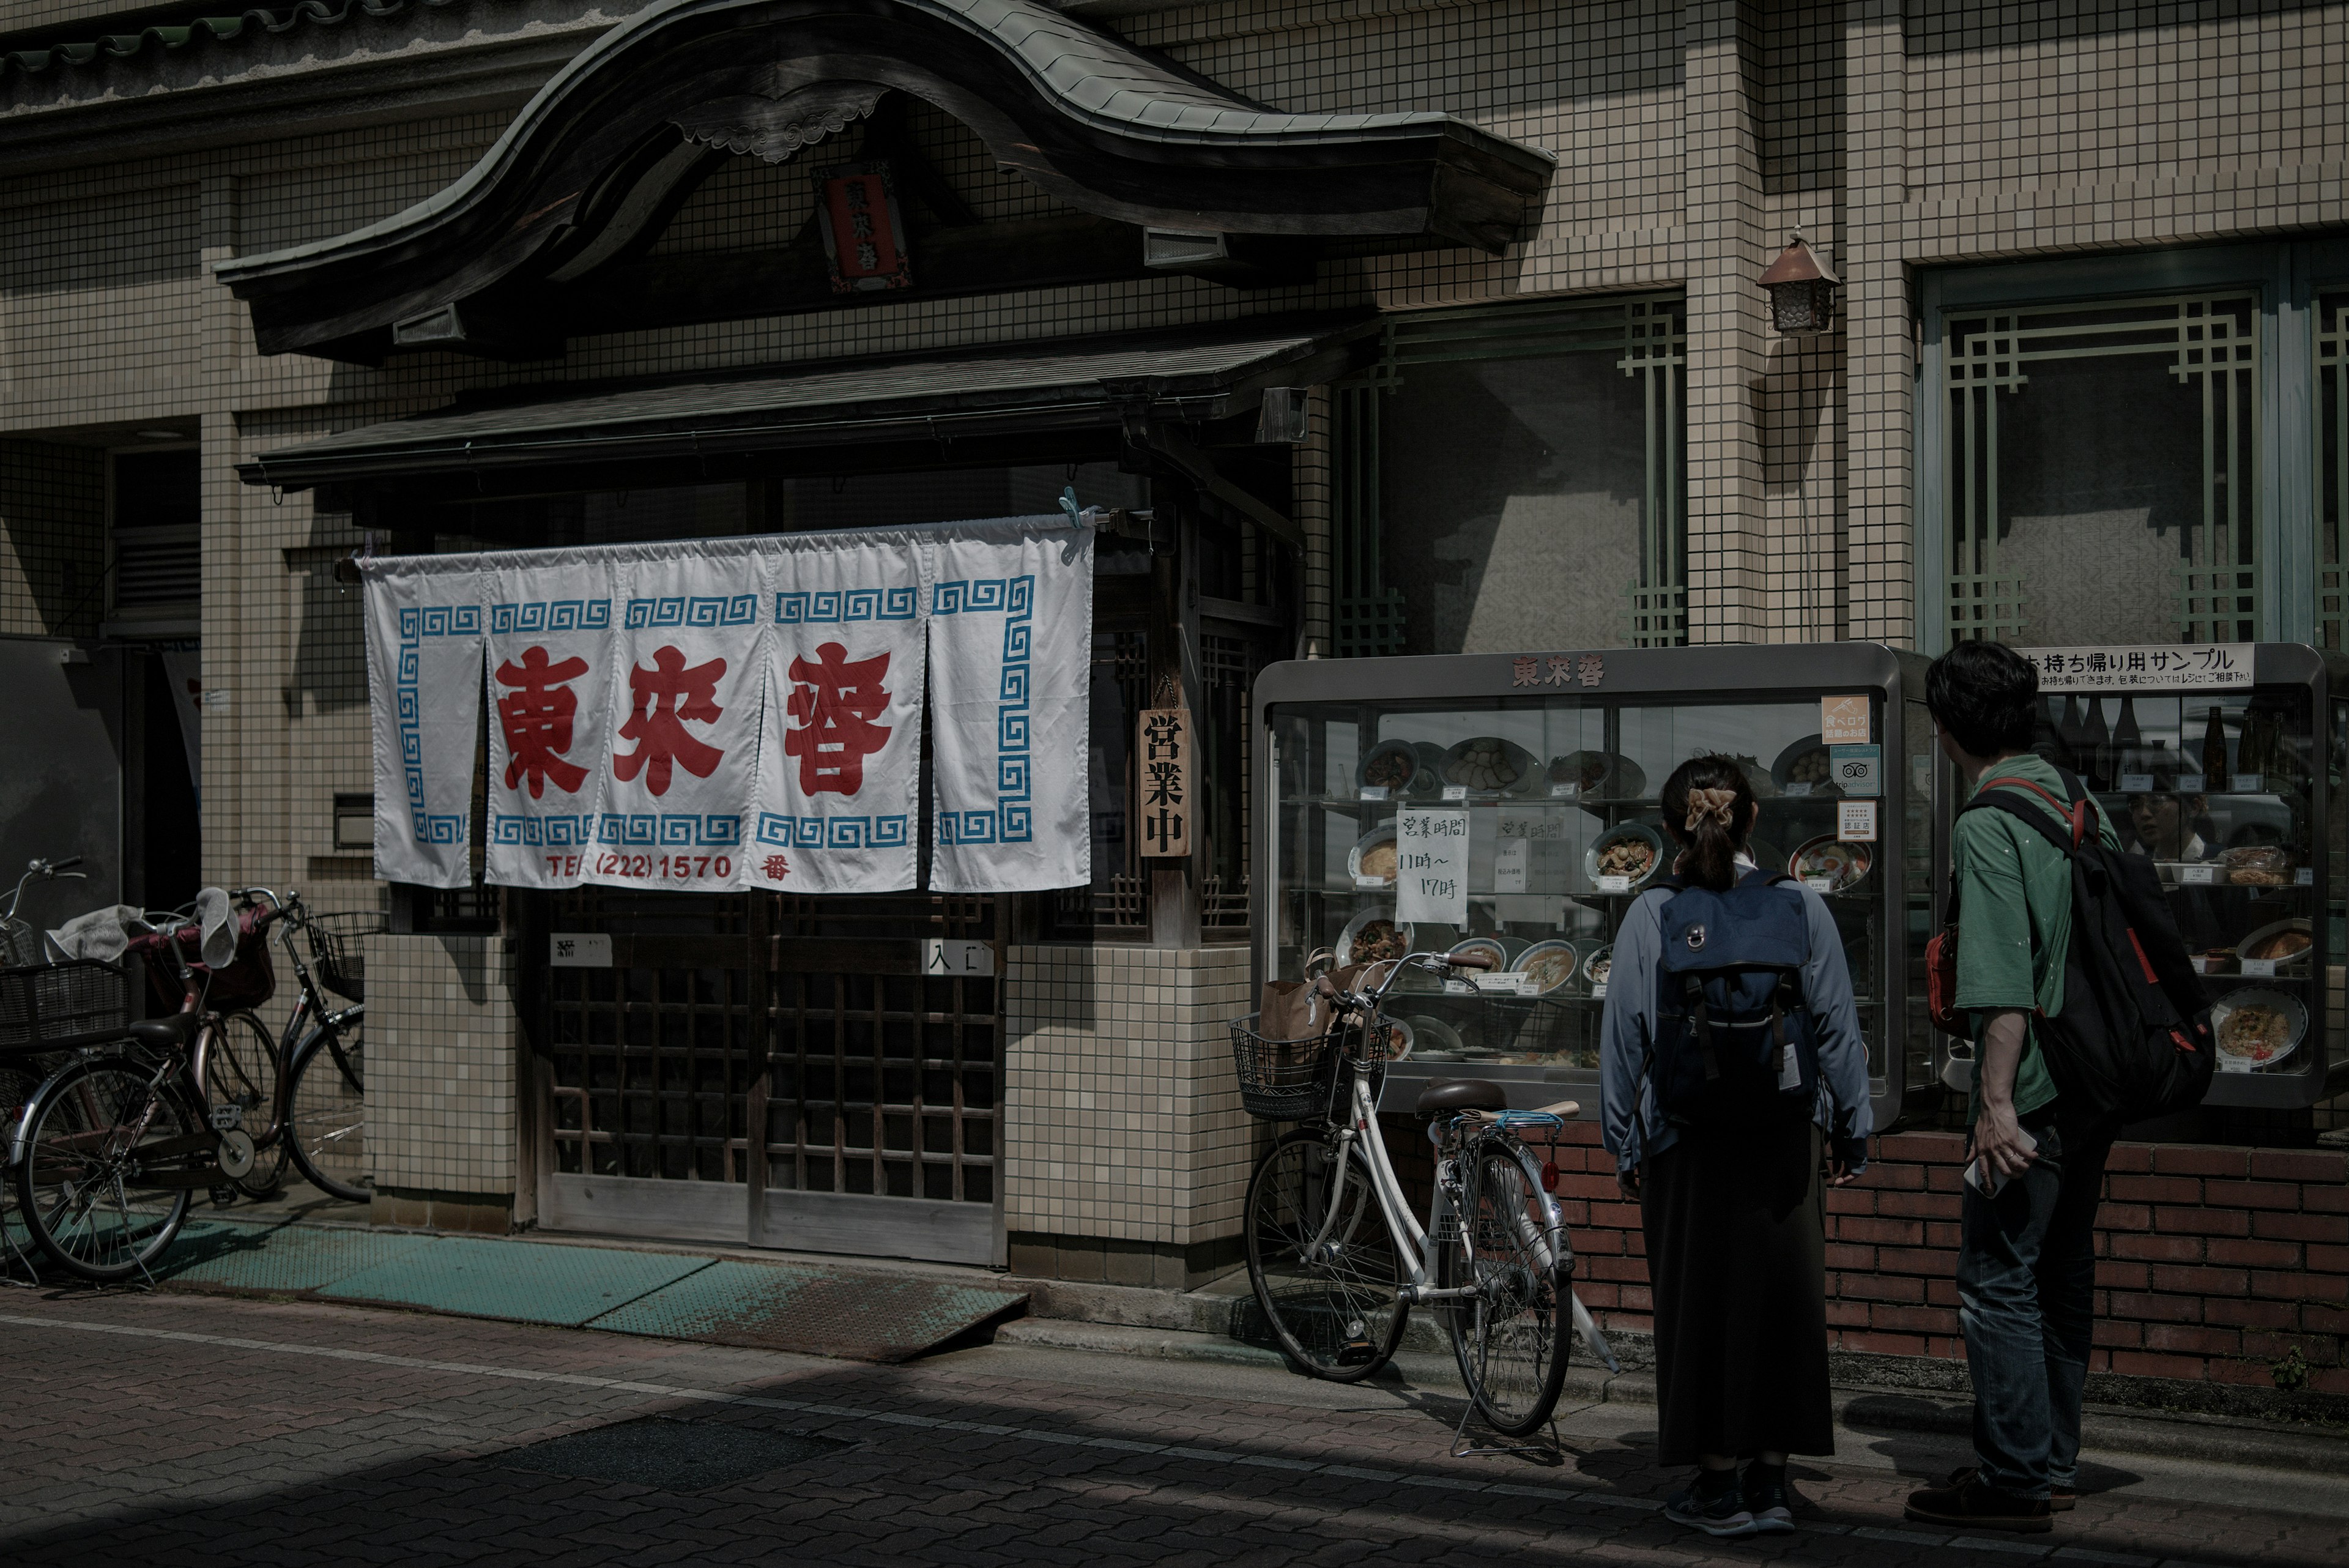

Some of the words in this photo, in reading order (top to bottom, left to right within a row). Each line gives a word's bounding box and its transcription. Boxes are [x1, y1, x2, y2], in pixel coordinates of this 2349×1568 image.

[1825, 714, 1866, 727] 食べログ
[1825, 728, 1866, 738] 話題のお店
[1144, 715, 1183, 853] 営業中
[1402, 816, 1466, 838] 営業時間
[760, 854, 792, 881] 番
[1421, 878, 1457, 900] 17時
